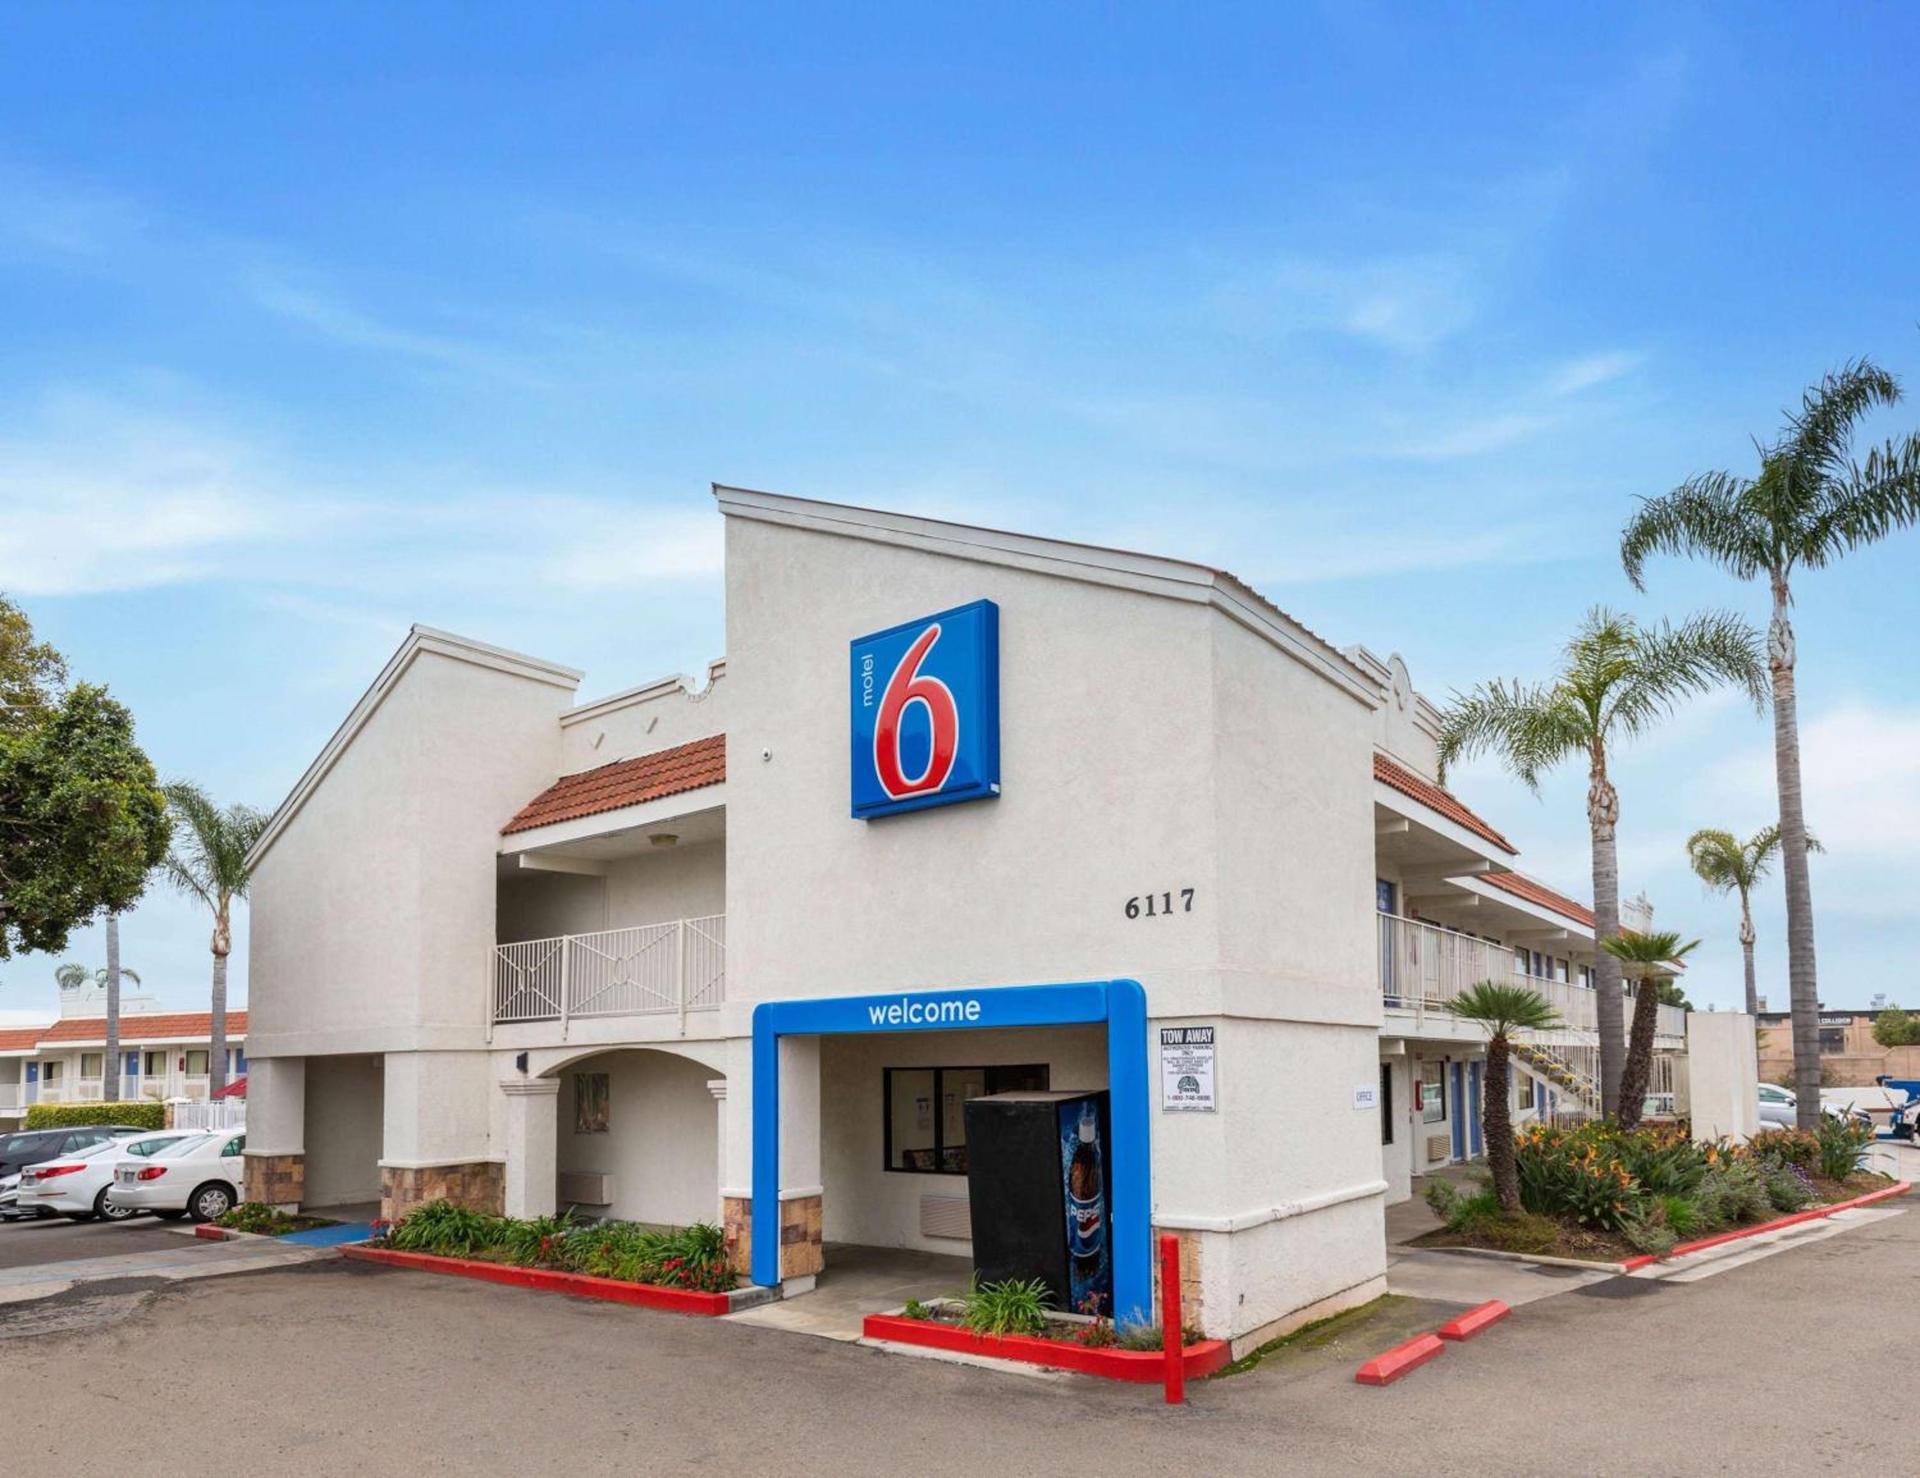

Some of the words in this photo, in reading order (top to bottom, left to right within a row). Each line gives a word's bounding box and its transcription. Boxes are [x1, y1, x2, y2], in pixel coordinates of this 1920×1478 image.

[861, 654, 874, 706] motel
[873, 622, 960, 801] 6
[1125, 888, 1195, 919] 6117
[868, 997, 981, 1025] welcome
[1162, 1030, 1184, 1044] TOW
[1185, 1028, 1213, 1043] AWAY
